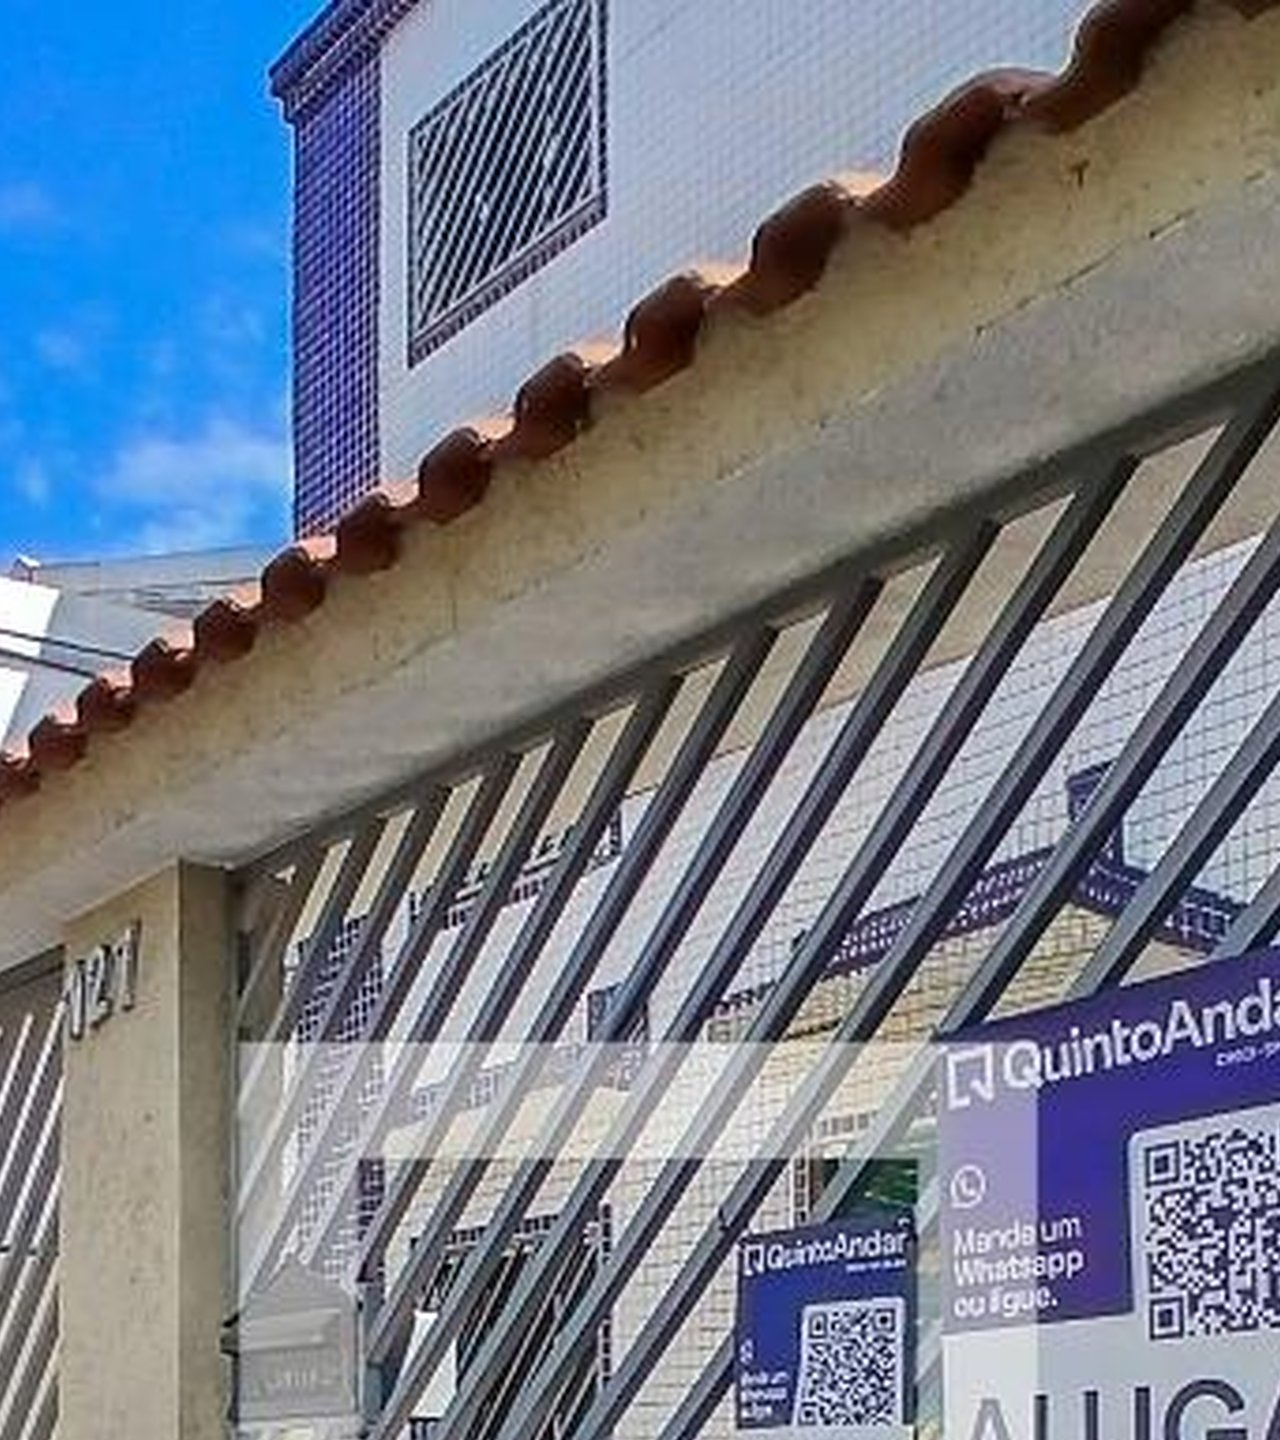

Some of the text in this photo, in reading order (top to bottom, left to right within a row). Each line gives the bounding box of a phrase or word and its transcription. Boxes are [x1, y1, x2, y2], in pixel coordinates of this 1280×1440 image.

[953, 1217, 1082, 1256] Manda um
[953, 1296, 986, 1318] ou
